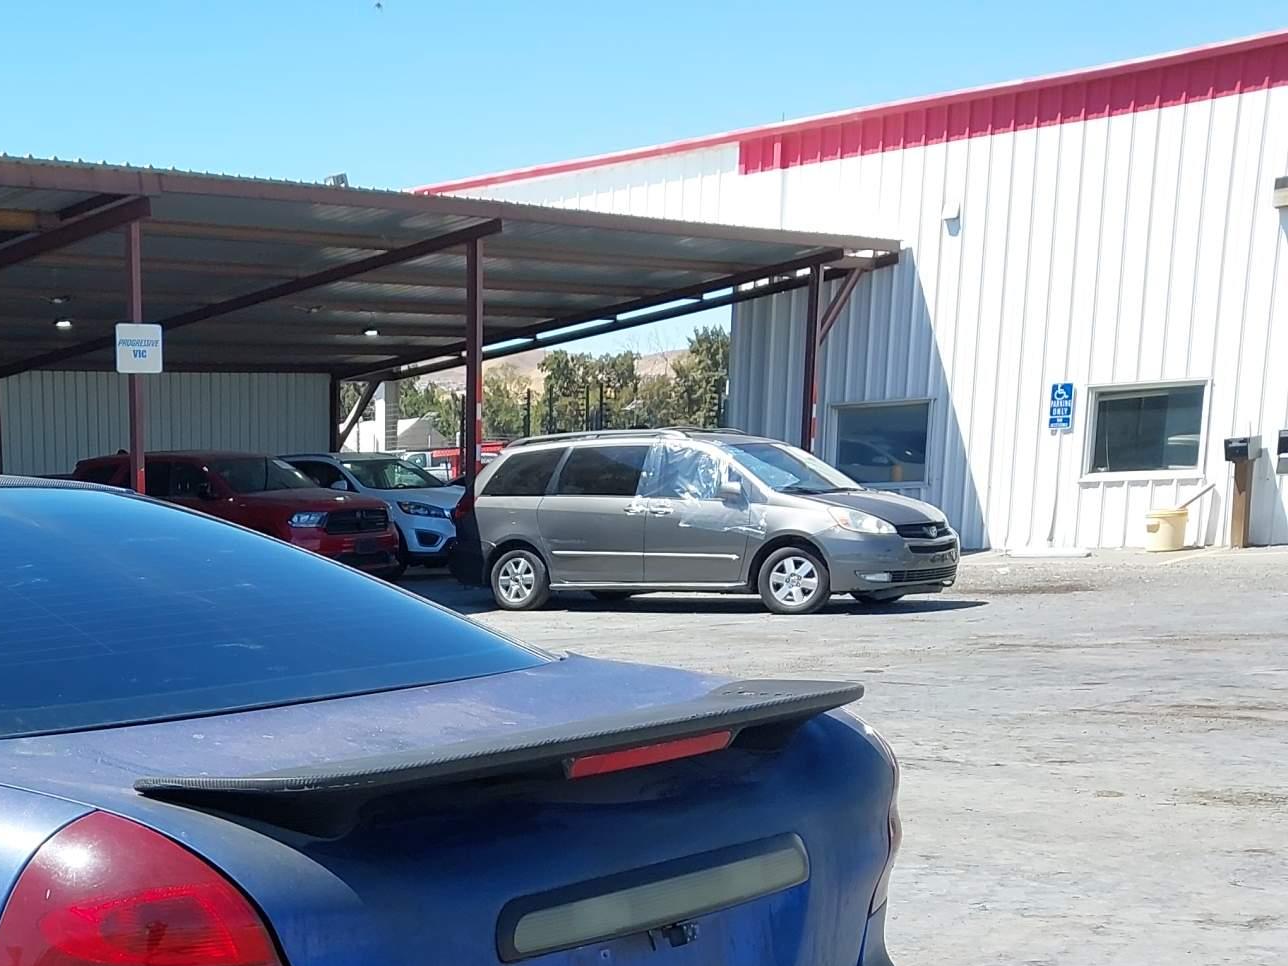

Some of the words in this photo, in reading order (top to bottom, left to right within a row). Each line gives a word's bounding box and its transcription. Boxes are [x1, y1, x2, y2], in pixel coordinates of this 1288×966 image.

[118, 339, 160, 347] PROGRESSIVE
[132, 349, 147, 358] VIC
[1050, 399, 1072, 407] PARKING
[1052, 407, 1069, 416] ONLY
